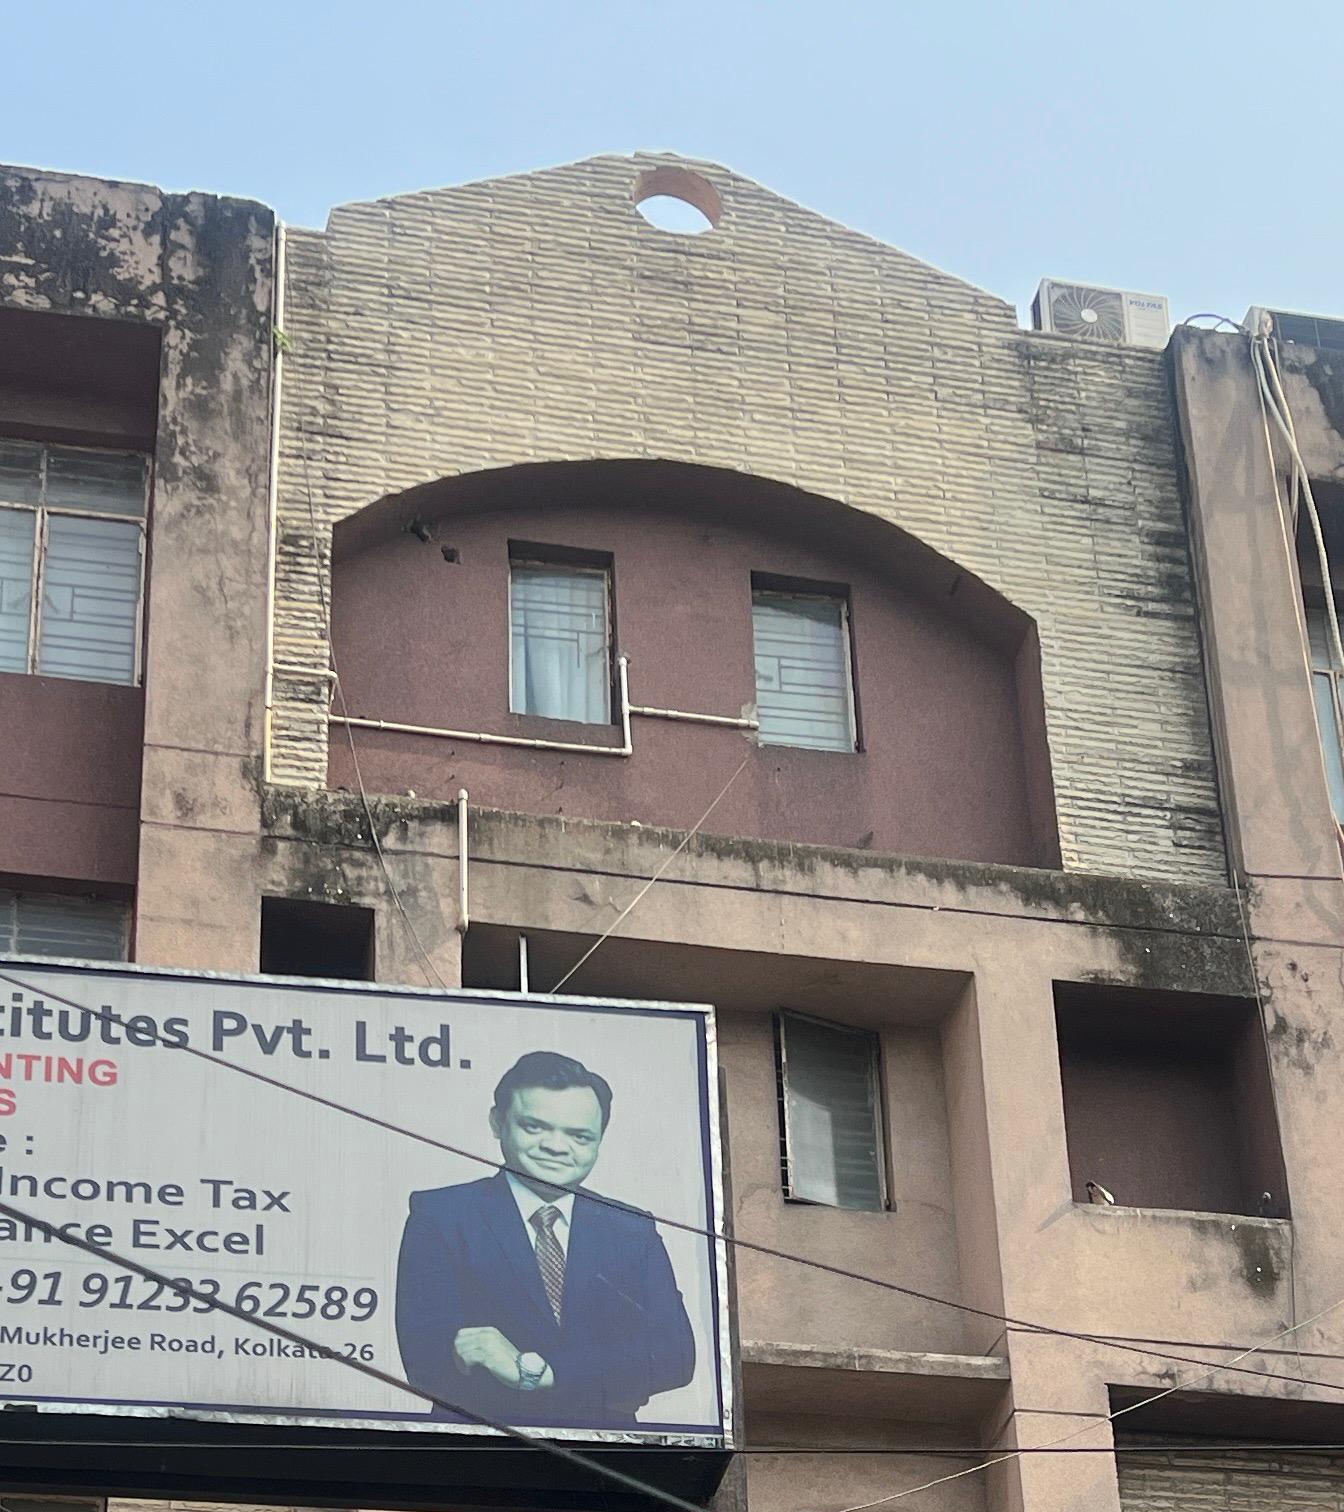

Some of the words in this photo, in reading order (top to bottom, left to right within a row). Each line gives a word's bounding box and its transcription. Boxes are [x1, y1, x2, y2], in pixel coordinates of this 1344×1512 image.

[212, 1009, 330, 1059] Pvt.
[356, 1020, 472, 1069] Ltd.
[200, 1178, 292, 1213] Tax
[132, 1219, 265, 1256] Excel
[78, 1272, 221, 1314] 91233
[234, 1280, 379, 1322] 62589
[0, 1325, 142, 1354] Mukherjee
[150, 1332, 225, 1360] Road,
